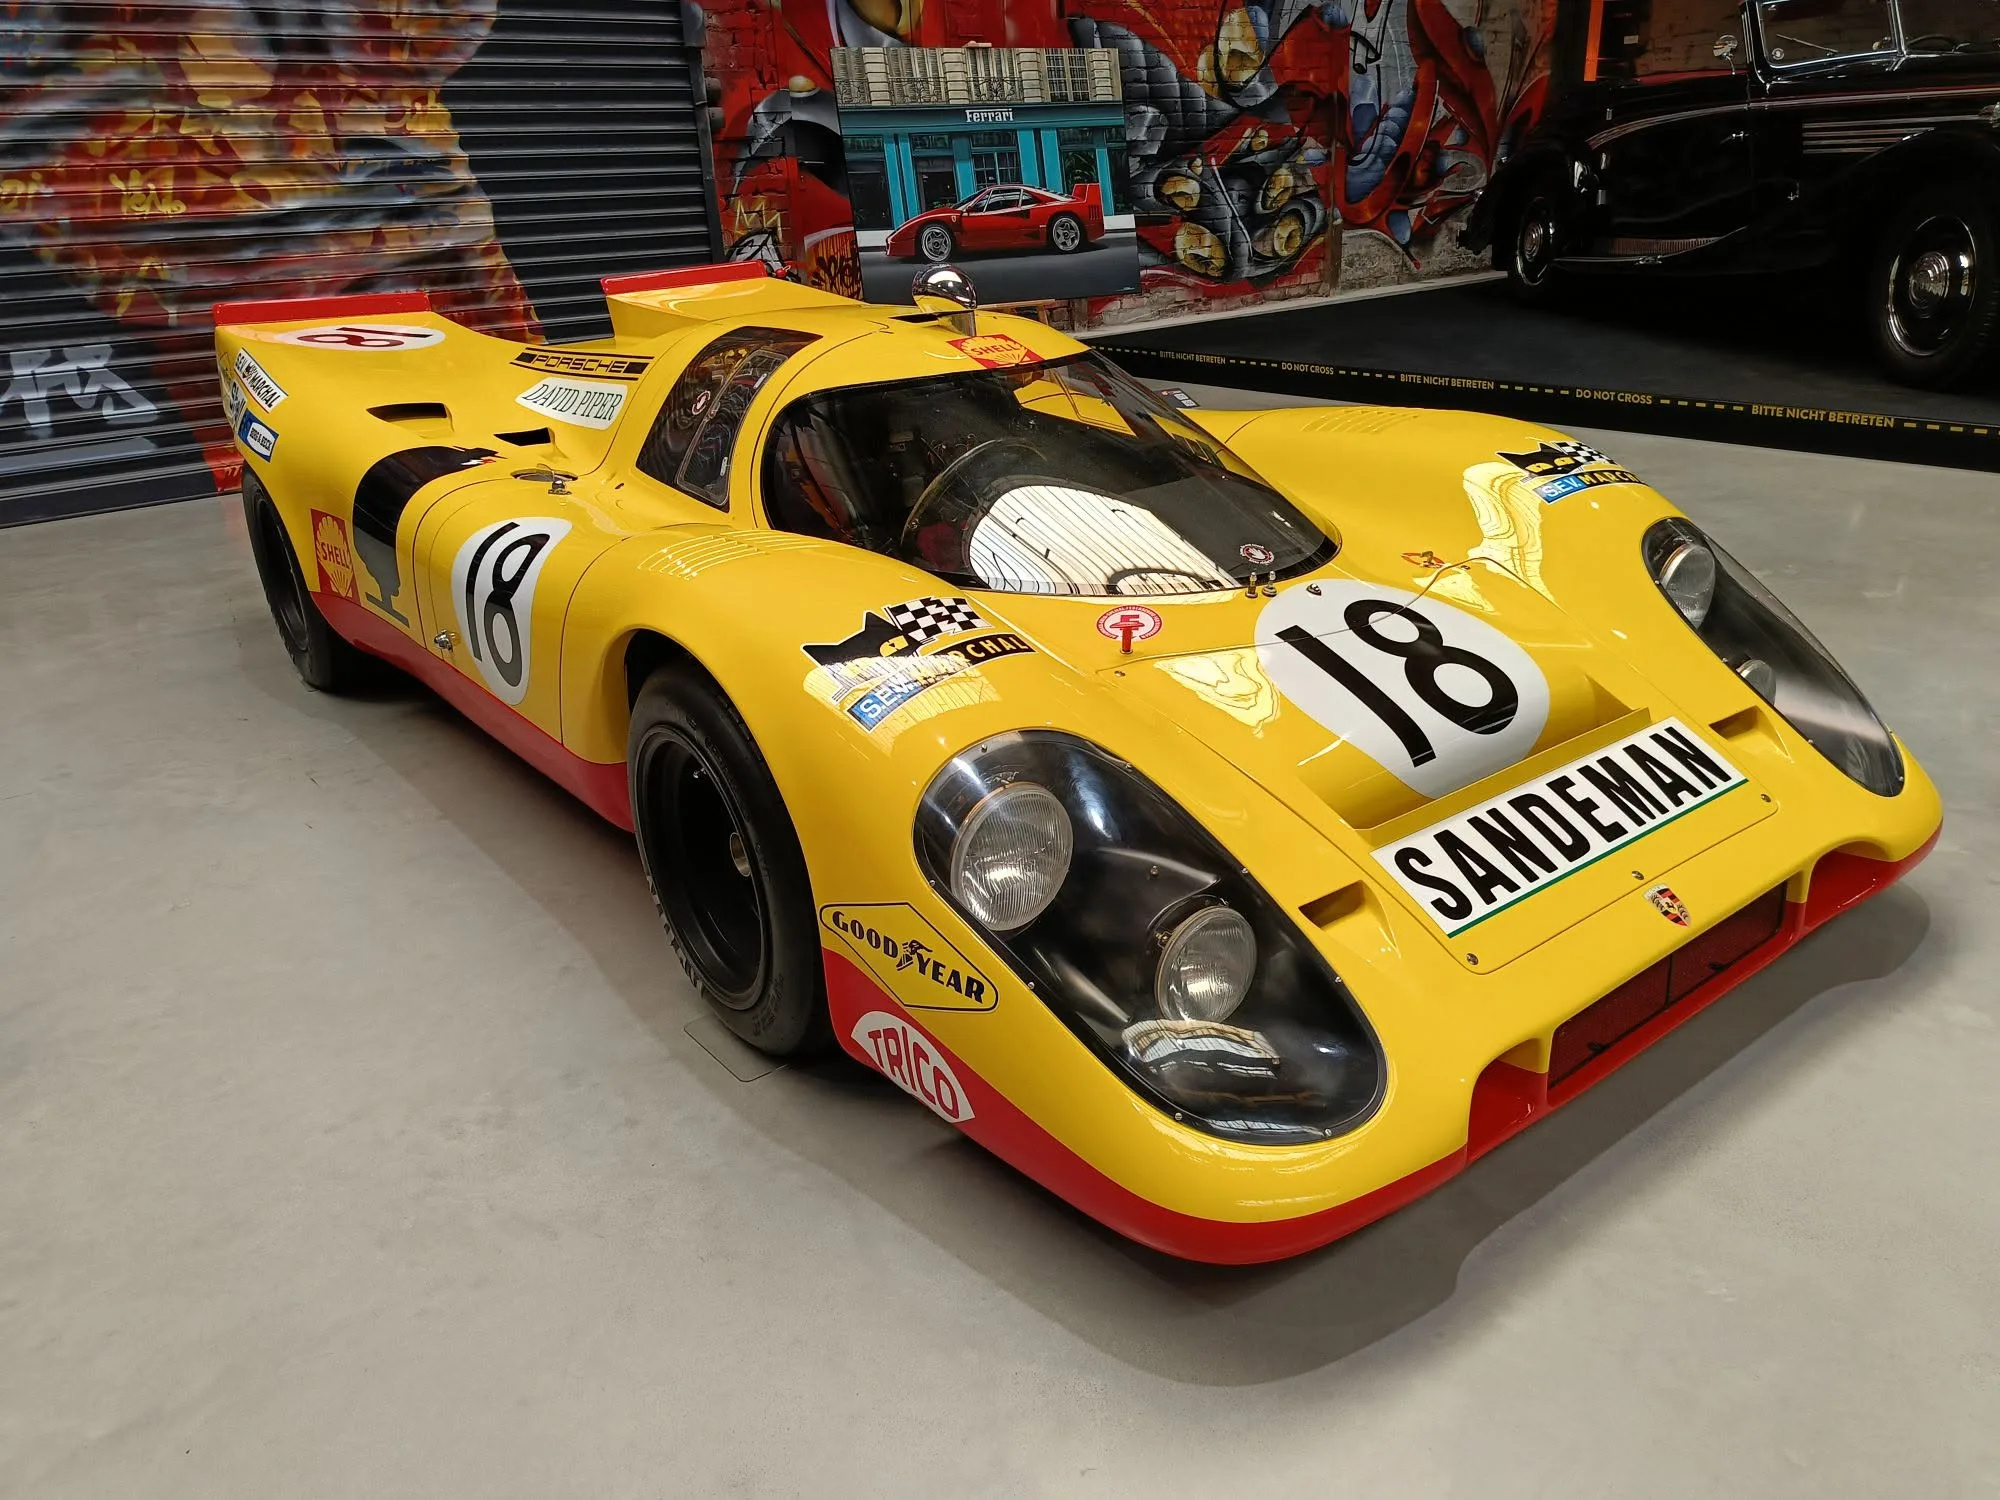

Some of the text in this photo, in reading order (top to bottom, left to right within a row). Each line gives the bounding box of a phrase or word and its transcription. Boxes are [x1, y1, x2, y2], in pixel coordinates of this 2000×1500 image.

[965, 108, 1014, 122] Ferrari
[971, 343, 1021, 355] SHELL
[1159, 350, 1226, 364] BITTE NICHT BETRETEN
[532, 354, 627, 374] PORSCHE
[1281, 362, 1334, 375] DO NOT CROSS
[1400, 373, 1495, 390] BITTE NICHT BETRETEN
[521, 383, 623, 421] DAVID PIPER
[1575, 388, 1653, 405] DO NOT CROSS
[1751, 404, 1896, 428] BITTE NICHT BETRETEN
[1577, 471, 1641, 485] MARCH
[321, 541, 351, 570] SHELL
[465, 521, 551, 688] 18
[1274, 599, 1519, 768] 18
[1394, 726, 1732, 921] SANDEMAN
[832, 911, 985, 1004] GOOD YEAR
[867, 1025, 960, 1119] TRICO
